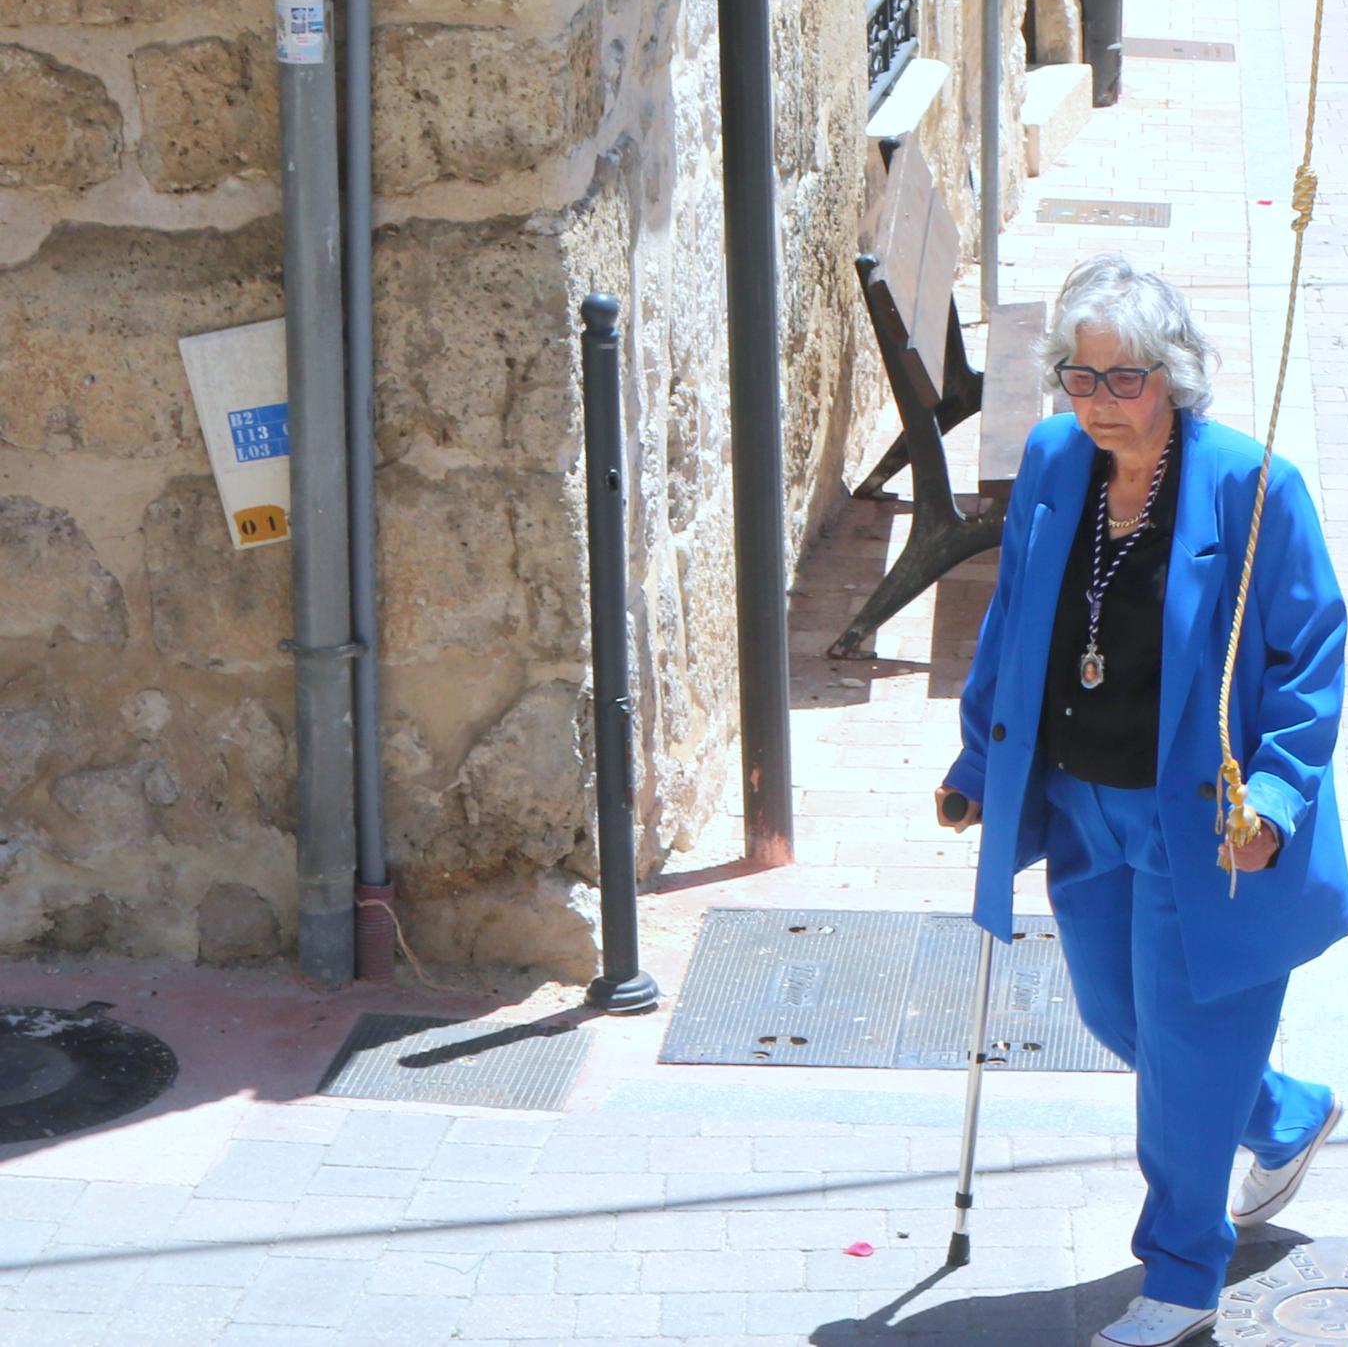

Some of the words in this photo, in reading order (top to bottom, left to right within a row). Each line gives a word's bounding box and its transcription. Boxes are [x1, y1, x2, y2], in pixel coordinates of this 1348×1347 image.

[229, 411, 255, 428] B2
[235, 425, 270, 444] 113
[236, 442, 271, 463] L03
